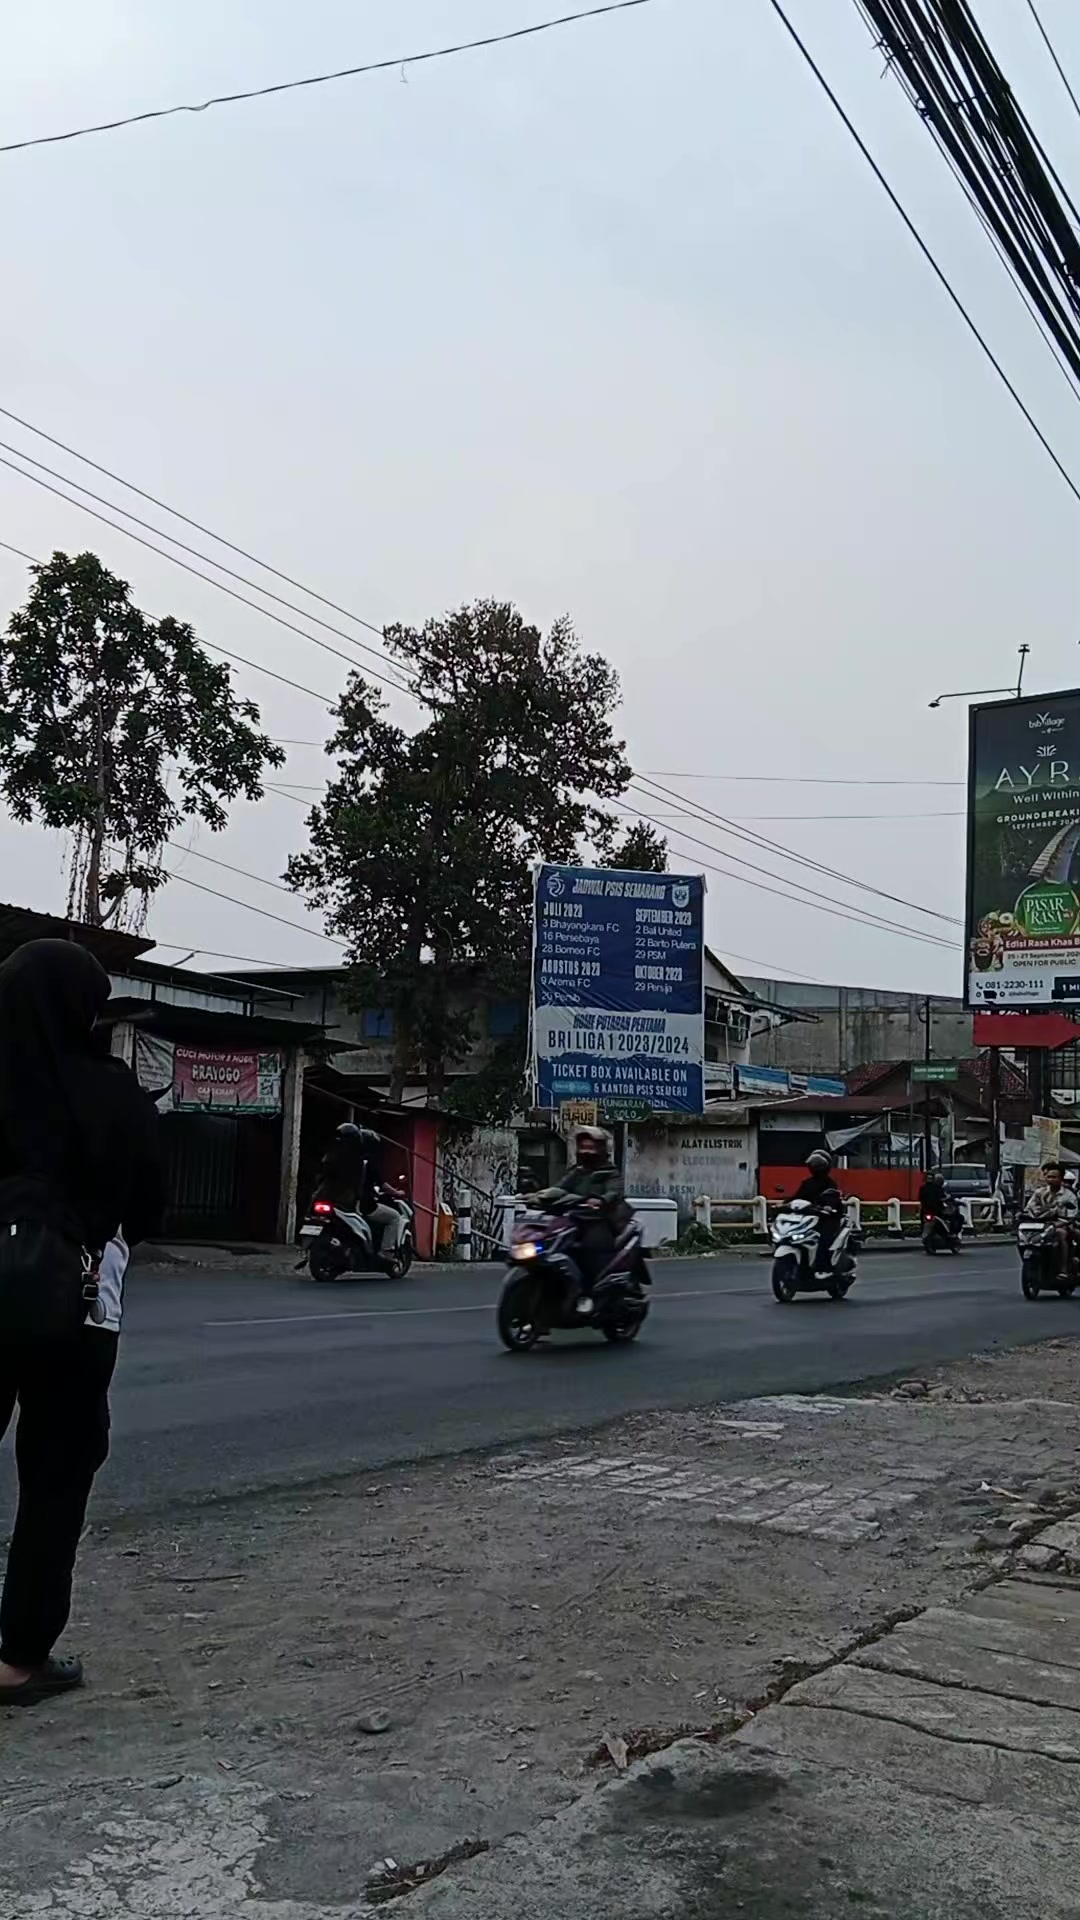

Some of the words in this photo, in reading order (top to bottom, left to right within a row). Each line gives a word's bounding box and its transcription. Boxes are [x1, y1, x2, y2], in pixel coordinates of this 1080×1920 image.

[994, 760, 1080, 790] AYR
[1013, 794, 1038, 804] Well
[1012, 820, 1057, 829] SEPTEMBER
[572, 878, 604, 896] JADWAL
[604, 882, 624, 897] PSIS
[624, 883, 666, 899] SEMARANG
[543, 902, 562, 916] JULI
[635, 908, 673, 923] SEPTEMBER
[542, 919, 548, 927] 3
[550, 920, 605, 932] Bhayangkara
[606, 923, 620, 932] FC
[635, 926, 641, 935] 2
[658, 927, 682, 936] United
[543, 932, 553, 940] 16
[555, 933, 599, 944] Persebaya
[635, 938, 647, 947] 22
[1006, 940, 1026, 948] Edisi
[1051, 938, 1072, 946] Khas
[542, 944, 553, 953] 28
[587, 947, 600, 956] FC
[635, 950, 646, 959] 29
[647, 951, 666, 960] PSM
[541, 959, 579, 975] AGUSTUS
[635, 965, 663, 980] OKTOBER
[577, 979, 591, 988] FC
[635, 982, 646, 992] 29
[596, 1016, 631, 1032] PUTARAN
[631, 1017, 666, 1033] PERTAMA
[548, 1030, 571, 1048] BRI
[576, 1032, 605, 1050] LIGA
[608, 1035, 613, 1050] 1
[619, 1035, 689, 1054] 2023/2024
[176, 1049, 197, 1059] CUCI
[192, 1064, 240, 1082] PRAYOGO
[552, 1063, 587, 1077] TICKET
[591, 1065, 611, 1078] BOX
[615, 1067, 670, 1081] AVAILABLE
[673, 1069, 687, 1082] ON
[601, 1084, 634, 1094] KANTOR
[636, 1085, 654, 1095] PSIS
[655, 1086, 687, 1096] SEMERU
